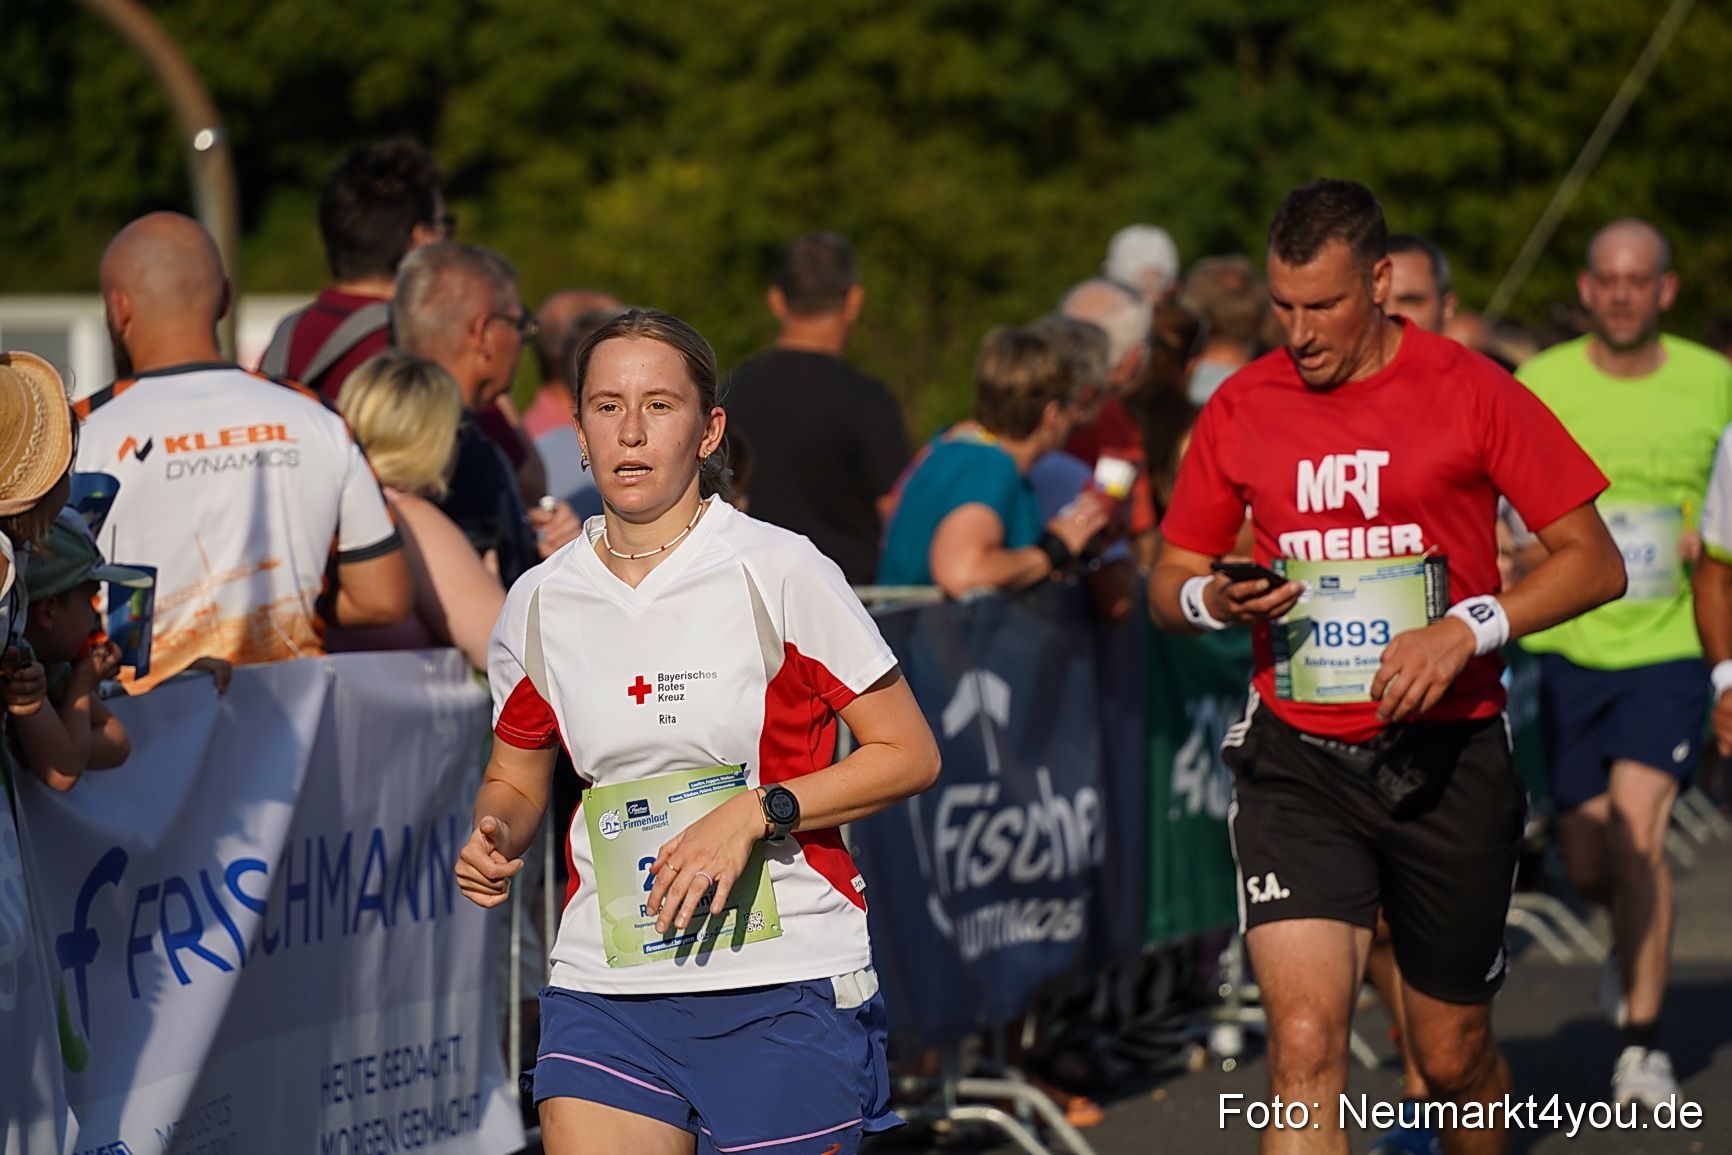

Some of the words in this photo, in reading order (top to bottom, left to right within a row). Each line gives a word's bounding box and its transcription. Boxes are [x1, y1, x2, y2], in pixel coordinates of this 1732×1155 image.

[165, 424, 298, 454] KLEBL
[166, 448, 300, 481] DYNAMICS
[1297, 449, 1390, 520] MRT
[1278, 523, 1424, 562] MEIER
[1312, 620, 1390, 648] 1893
[657, 670, 718, 683] Bayerisches
[657, 681, 685, 693] Rotes
[657, 692, 685, 703] Kreuz
[659, 713, 677, 725] Rita
[623, 810, 669, 831] Firmenlauf
[642, 820, 670, 832] neumarkt
[1247, 872, 1291, 904] S.A.
[320, 1055, 377, 1106] HEUTE
